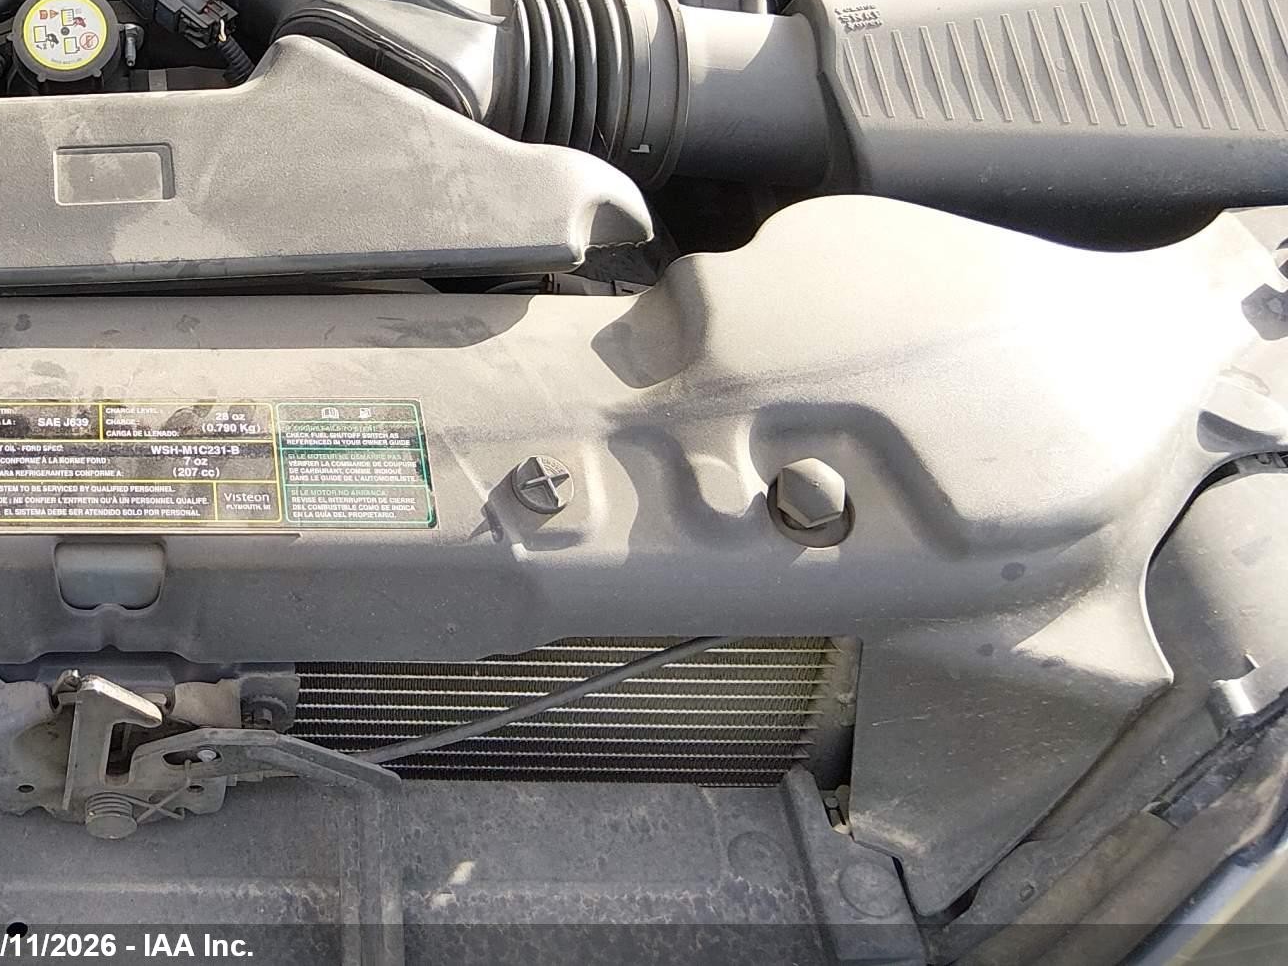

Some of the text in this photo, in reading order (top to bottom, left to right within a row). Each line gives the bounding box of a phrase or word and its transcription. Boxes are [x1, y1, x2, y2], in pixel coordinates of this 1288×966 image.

[215, 413, 229, 421] 28
[37, 418, 89, 427] SAE J639
[202, 423, 261, 434] (0.790 Kg)
[150, 445, 240, 455] WSH-M1C231-B
[184, 457, 208, 466] 7 oz
[172, 467, 220, 478] (207 cc)
[223, 492, 270, 502] Visteon
